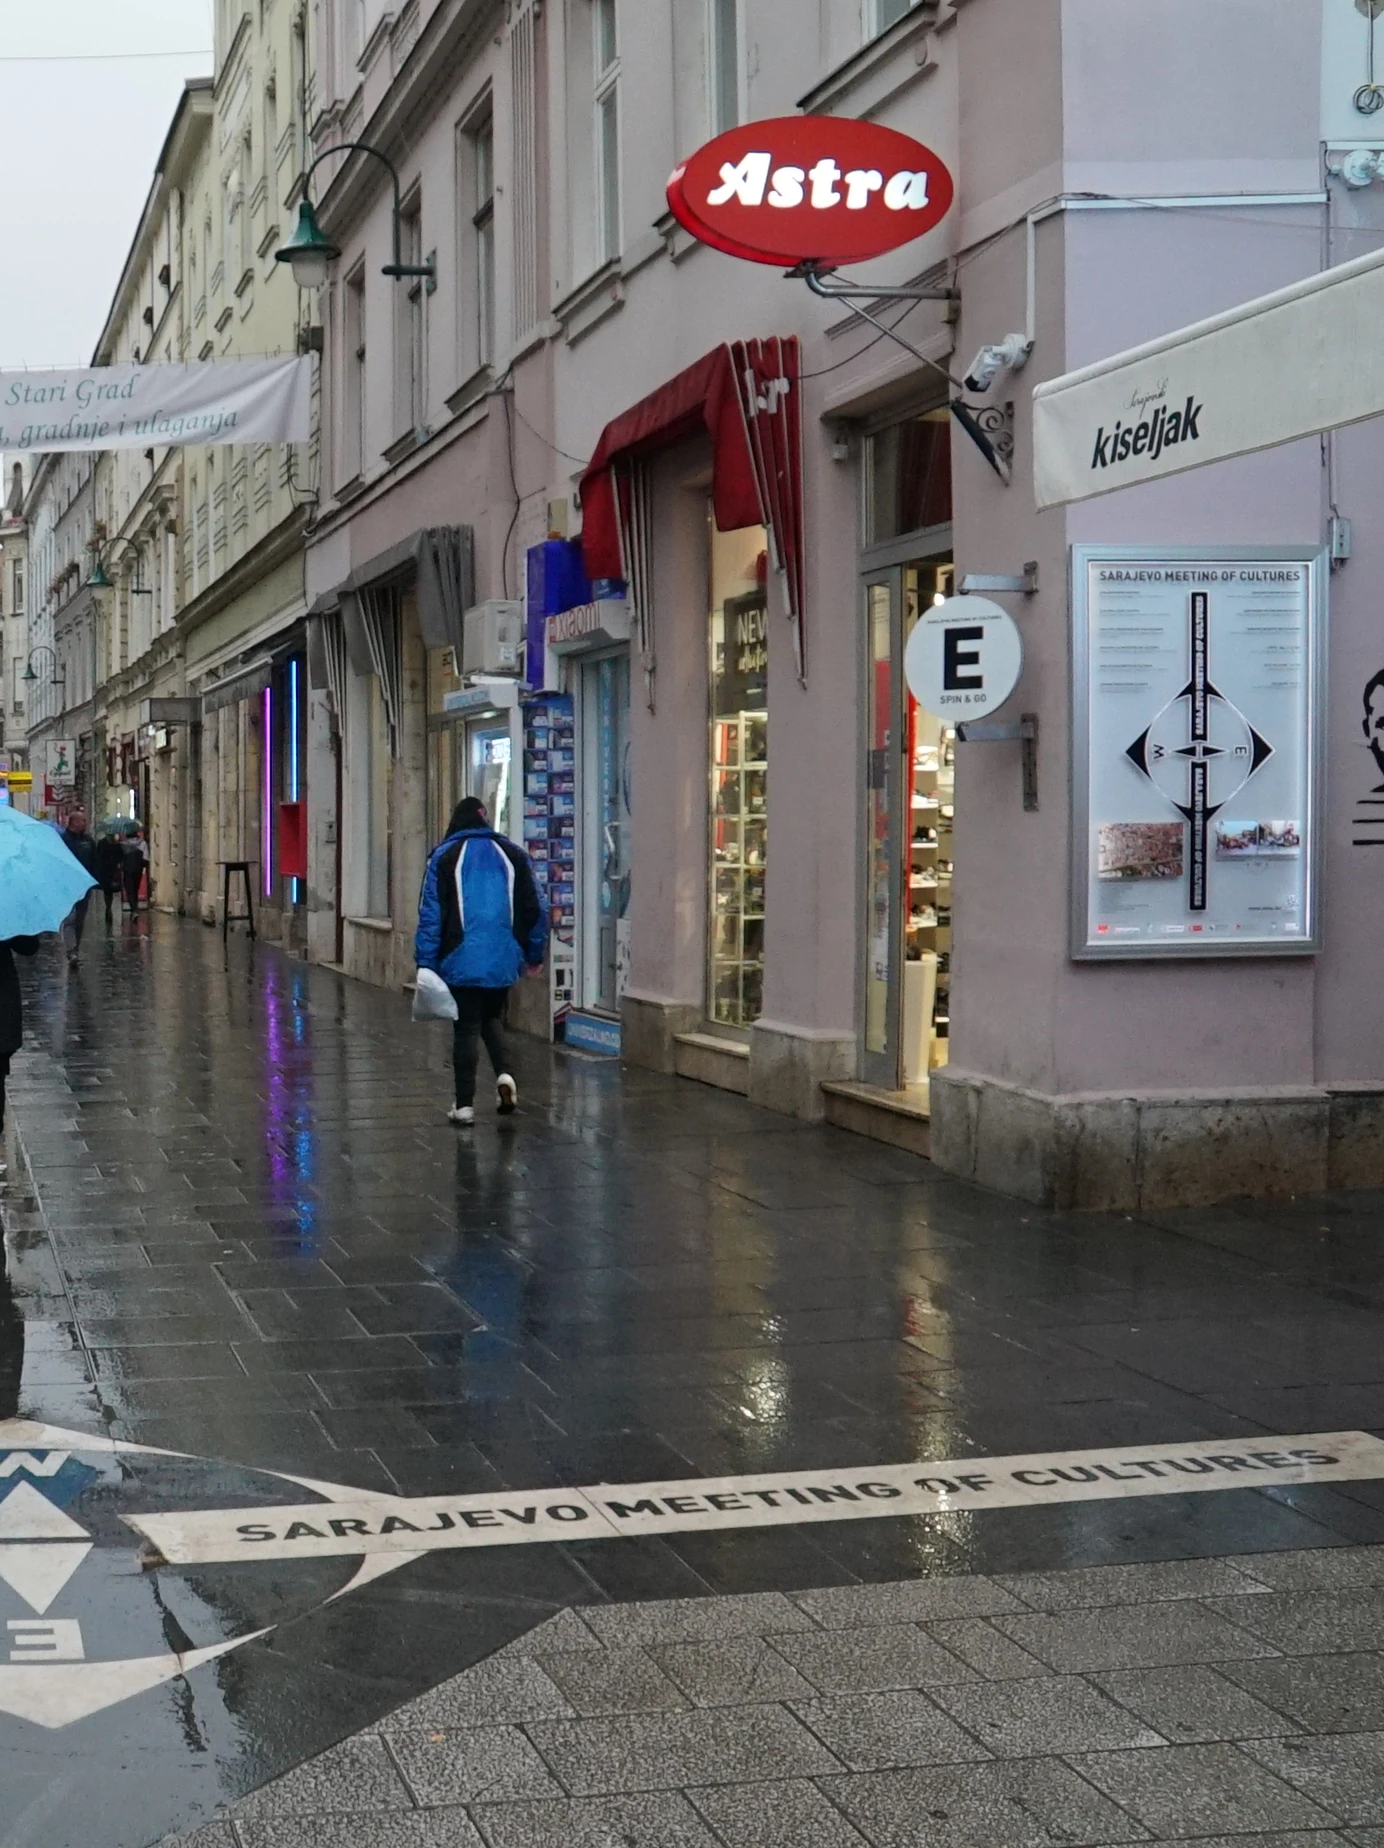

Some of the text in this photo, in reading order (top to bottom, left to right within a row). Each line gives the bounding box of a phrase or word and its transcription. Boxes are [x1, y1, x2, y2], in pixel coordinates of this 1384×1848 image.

[706, 152, 929, 210] Astra
[5, 379, 67, 405] Stari
[76, 373, 141, 409] Grad
[17, 413, 110, 449] gradnje
[118, 413, 127, 436] i
[134, 407, 239, 438] ulaganja
[1091, 395, 1204, 470] kiseljak
[1100, 570, 1301, 582] SARAJEVO MEETING OF CULTURES
[943, 626, 984, 691] E
[940, 694, 962, 705] SPIN
[964, 694, 972, 703] &
[235, 1449, 1341, 1543] SARAJEVO MEETING OF CULTURES
